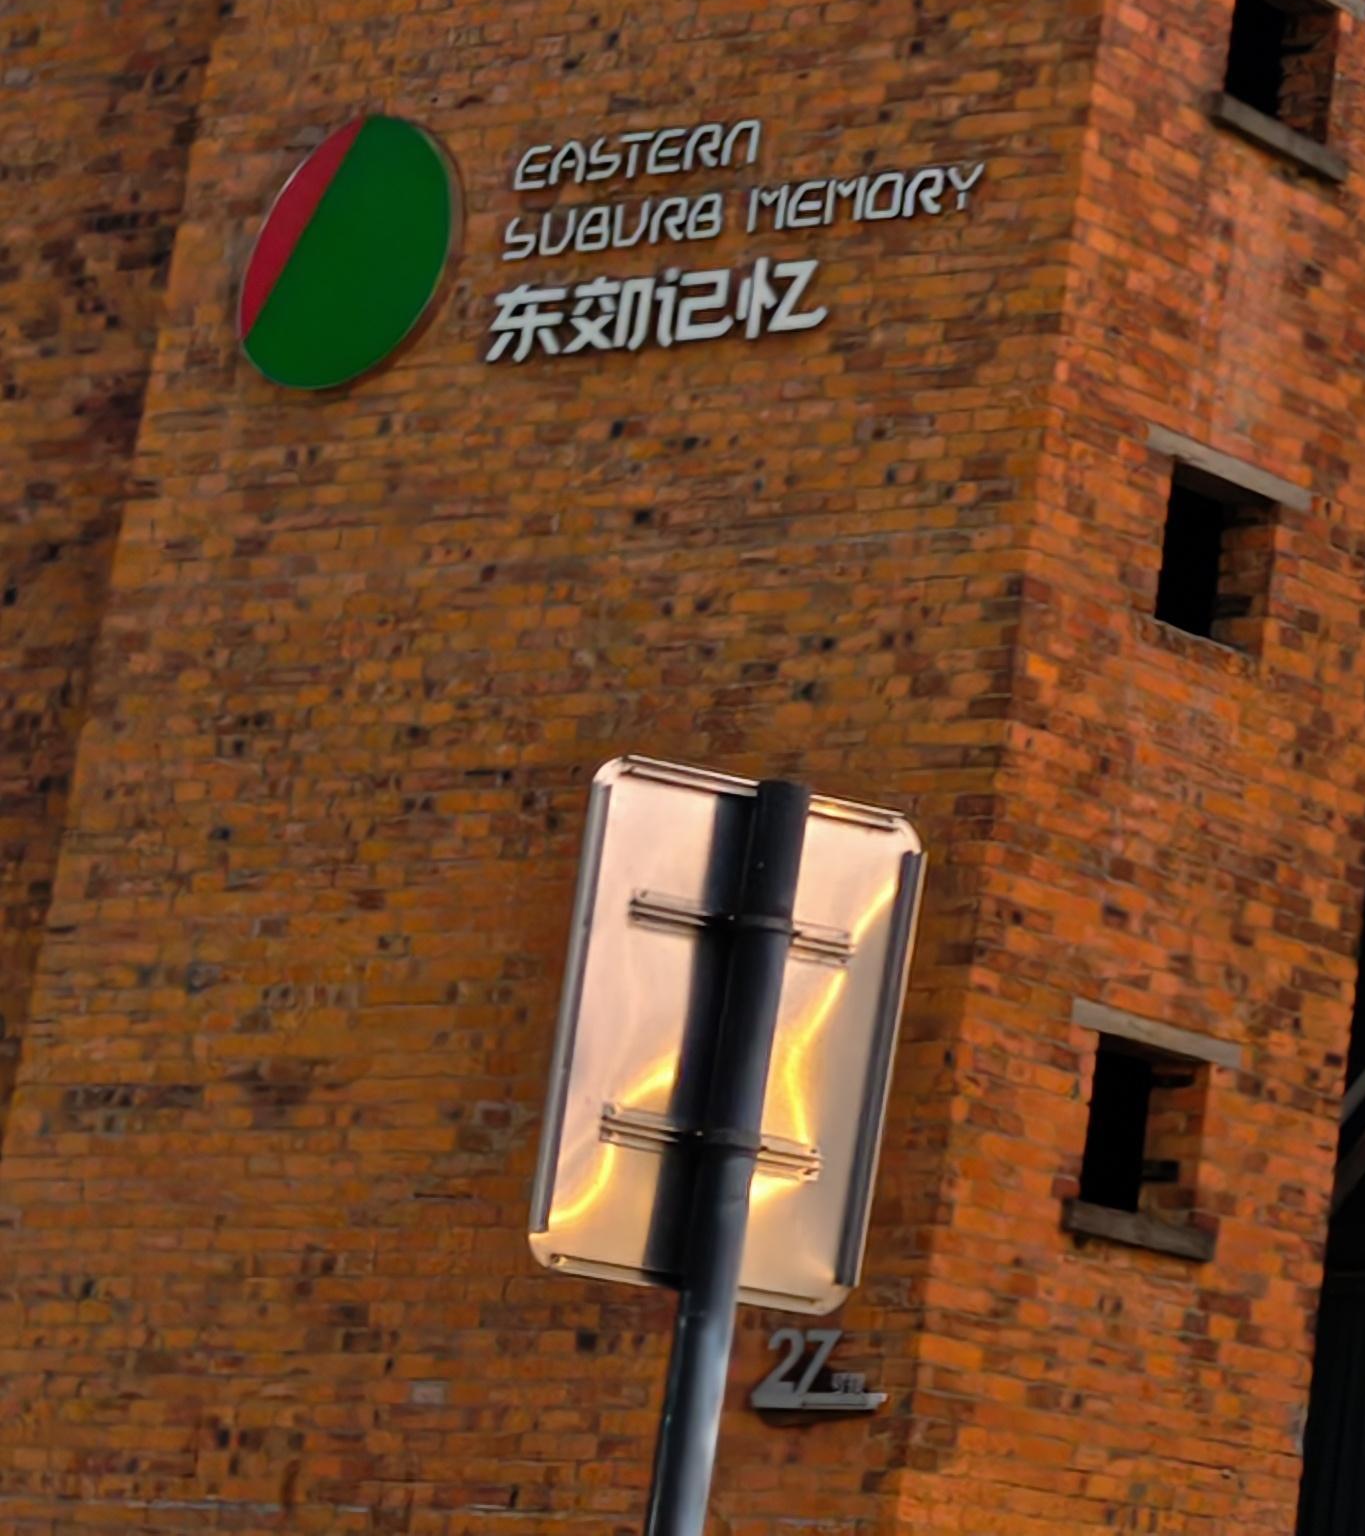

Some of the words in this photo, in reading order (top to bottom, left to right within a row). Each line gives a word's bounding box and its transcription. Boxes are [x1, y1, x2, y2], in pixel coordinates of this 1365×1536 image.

[513, 119, 761, 191] EASTERN
[502, 192, 723, 261] SUBURB
[746, 163, 985, 234] MEMORY
[485, 256, 828, 363] 东郊记忆
[752, 1327, 843, 1409] 27
